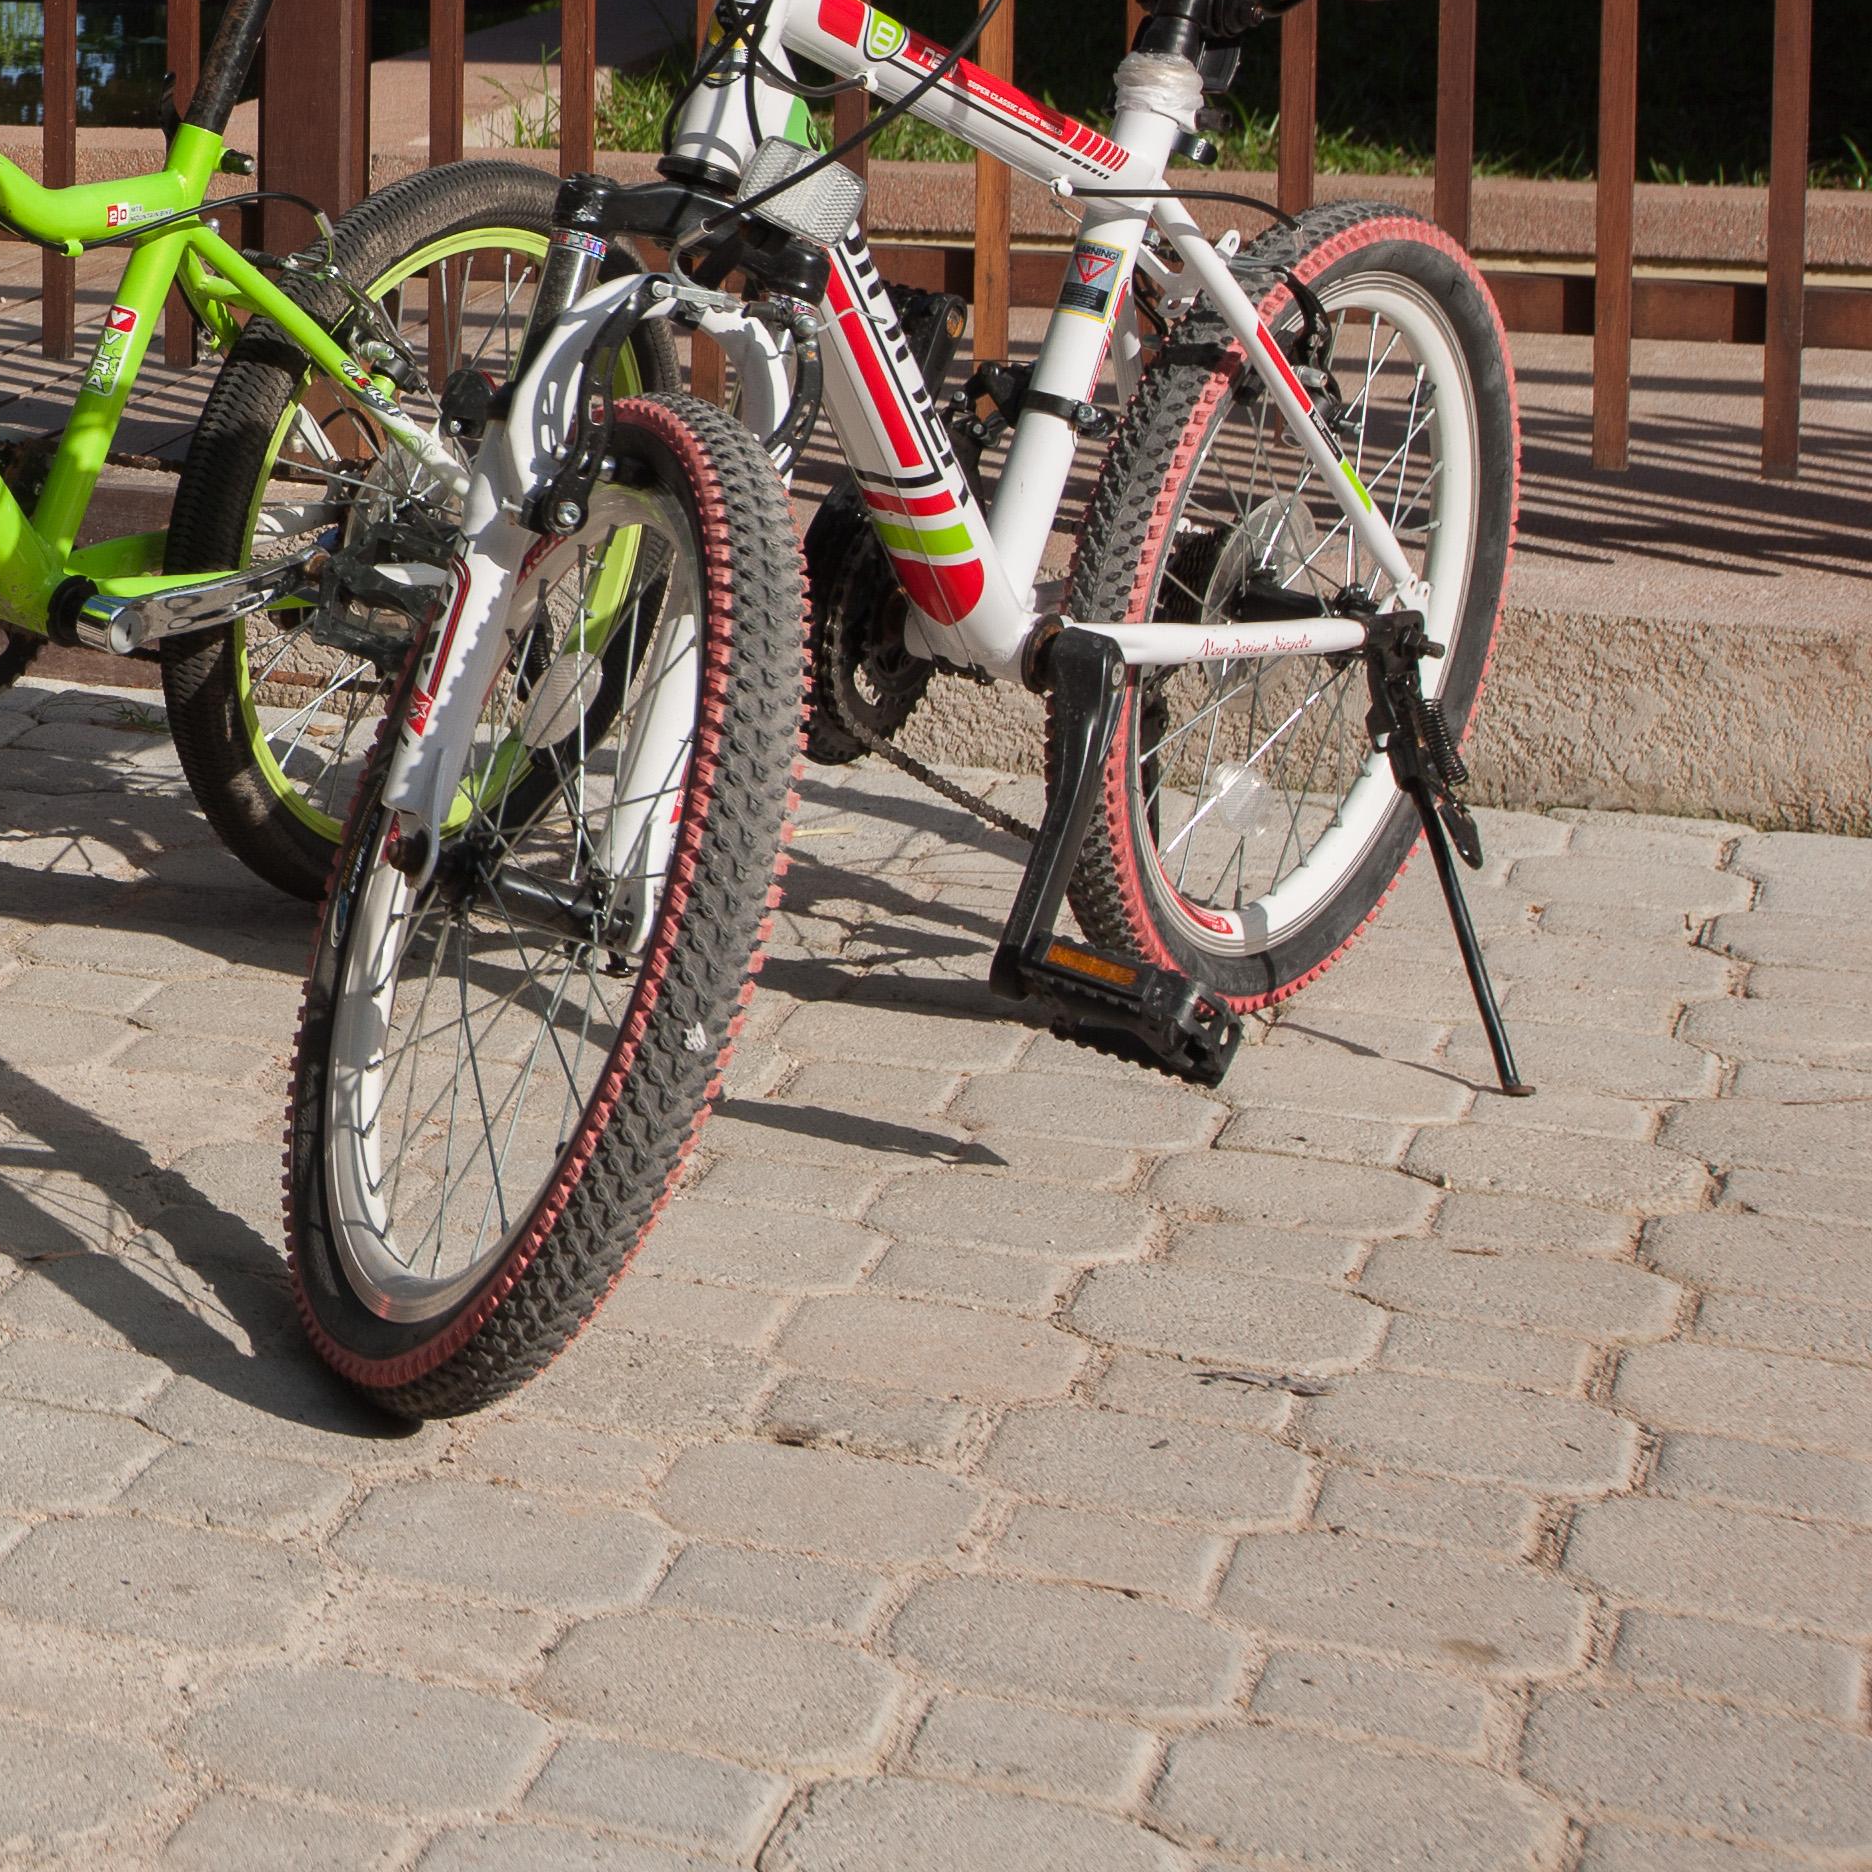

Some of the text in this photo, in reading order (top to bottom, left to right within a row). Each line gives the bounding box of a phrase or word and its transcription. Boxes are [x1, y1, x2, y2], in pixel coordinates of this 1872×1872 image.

[967, 79, 991, 99] SUPER
[990, 91, 1019, 114] CLASSIC
[1017, 106, 1041, 124] SPORT
[108, 208, 127, 224] 20
[1186, 633, 1313, 660] New design bicycle
